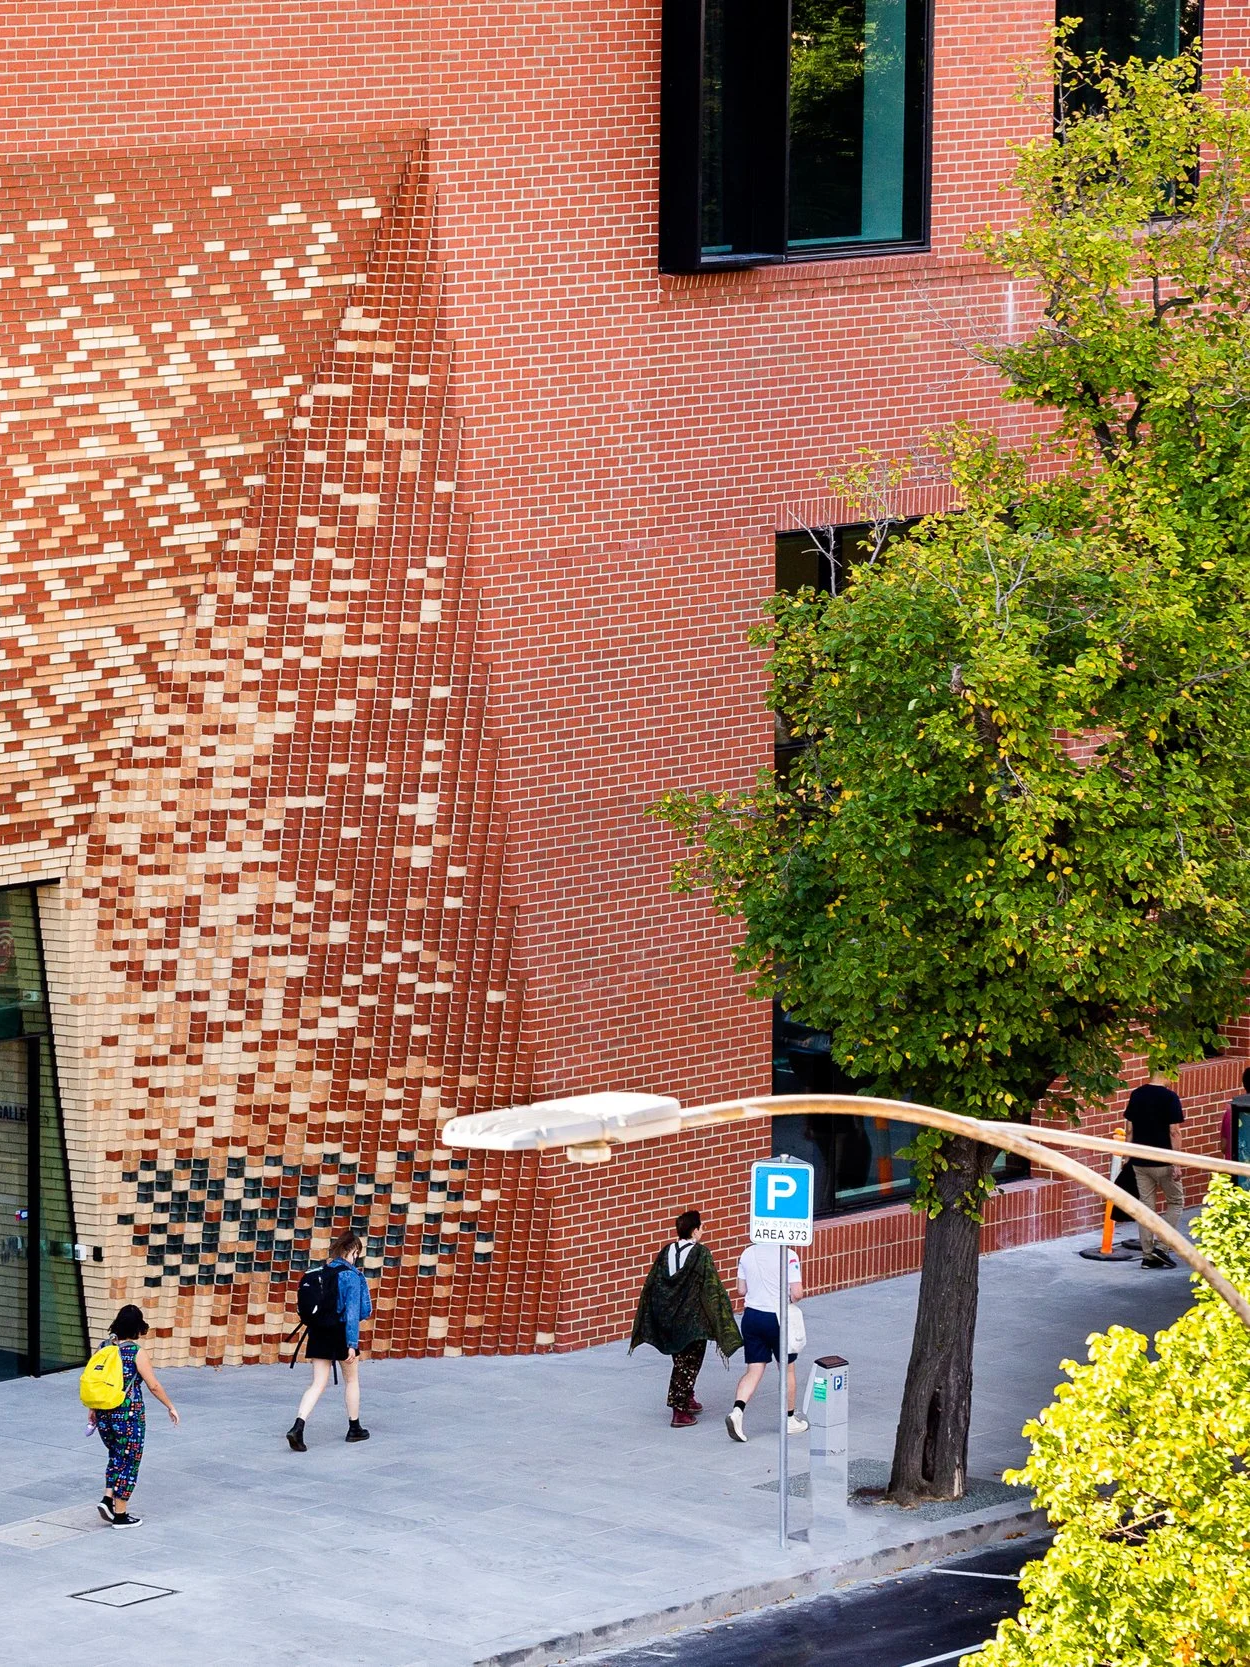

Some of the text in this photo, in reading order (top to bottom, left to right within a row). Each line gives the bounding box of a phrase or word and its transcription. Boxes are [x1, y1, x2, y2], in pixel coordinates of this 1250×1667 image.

[767, 1174, 797, 1211] P
[754, 1219, 809, 1229] PAY STATION
[755, 1228, 808, 1241] AREA 373
[835, 1377, 841, 1390] P
